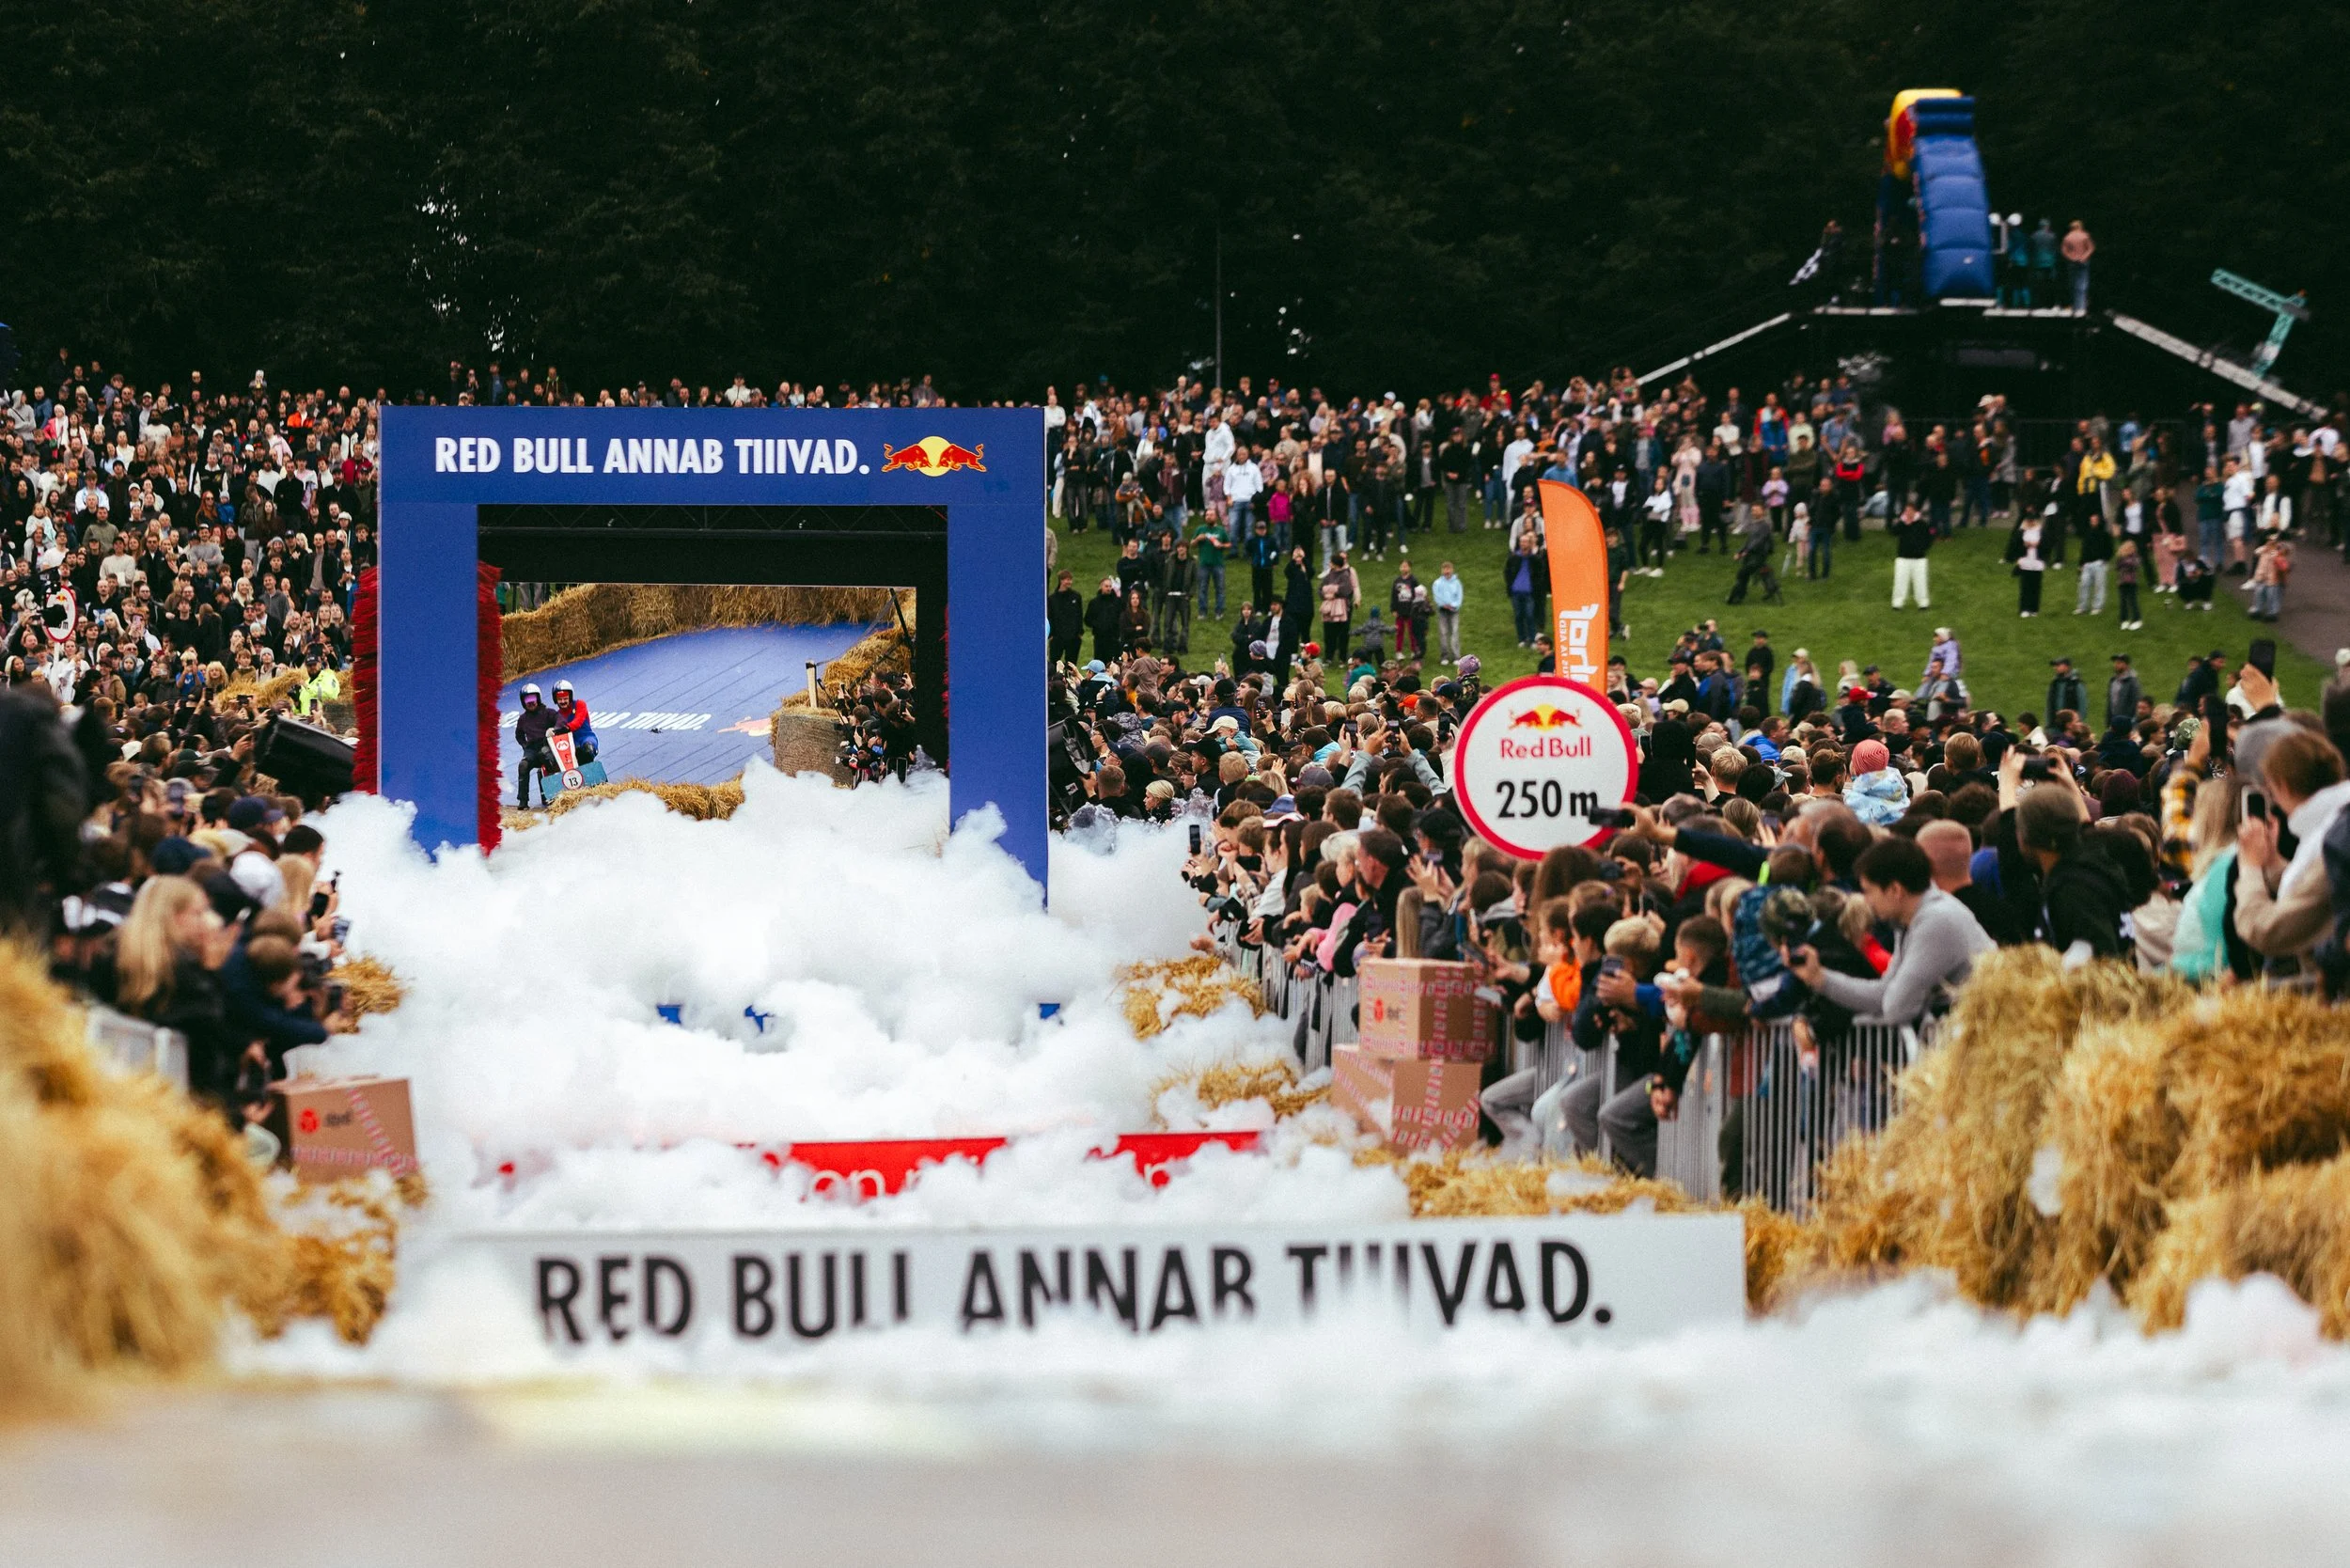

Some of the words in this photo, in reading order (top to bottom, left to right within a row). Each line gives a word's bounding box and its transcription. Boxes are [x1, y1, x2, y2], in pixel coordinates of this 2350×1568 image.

[435, 437, 501, 473] RED
[513, 437, 594, 474] BULL
[603, 438, 724, 474] ANNAB
[733, 438, 870, 475] TIIIVAD.
[1499, 736, 1544, 759] Red
[1548, 736, 1591, 758] Bull
[569, 776, 579, 788] 13
[536, 1254, 696, 1344] RED
[1285, 1241, 1613, 1327] TVAD.
